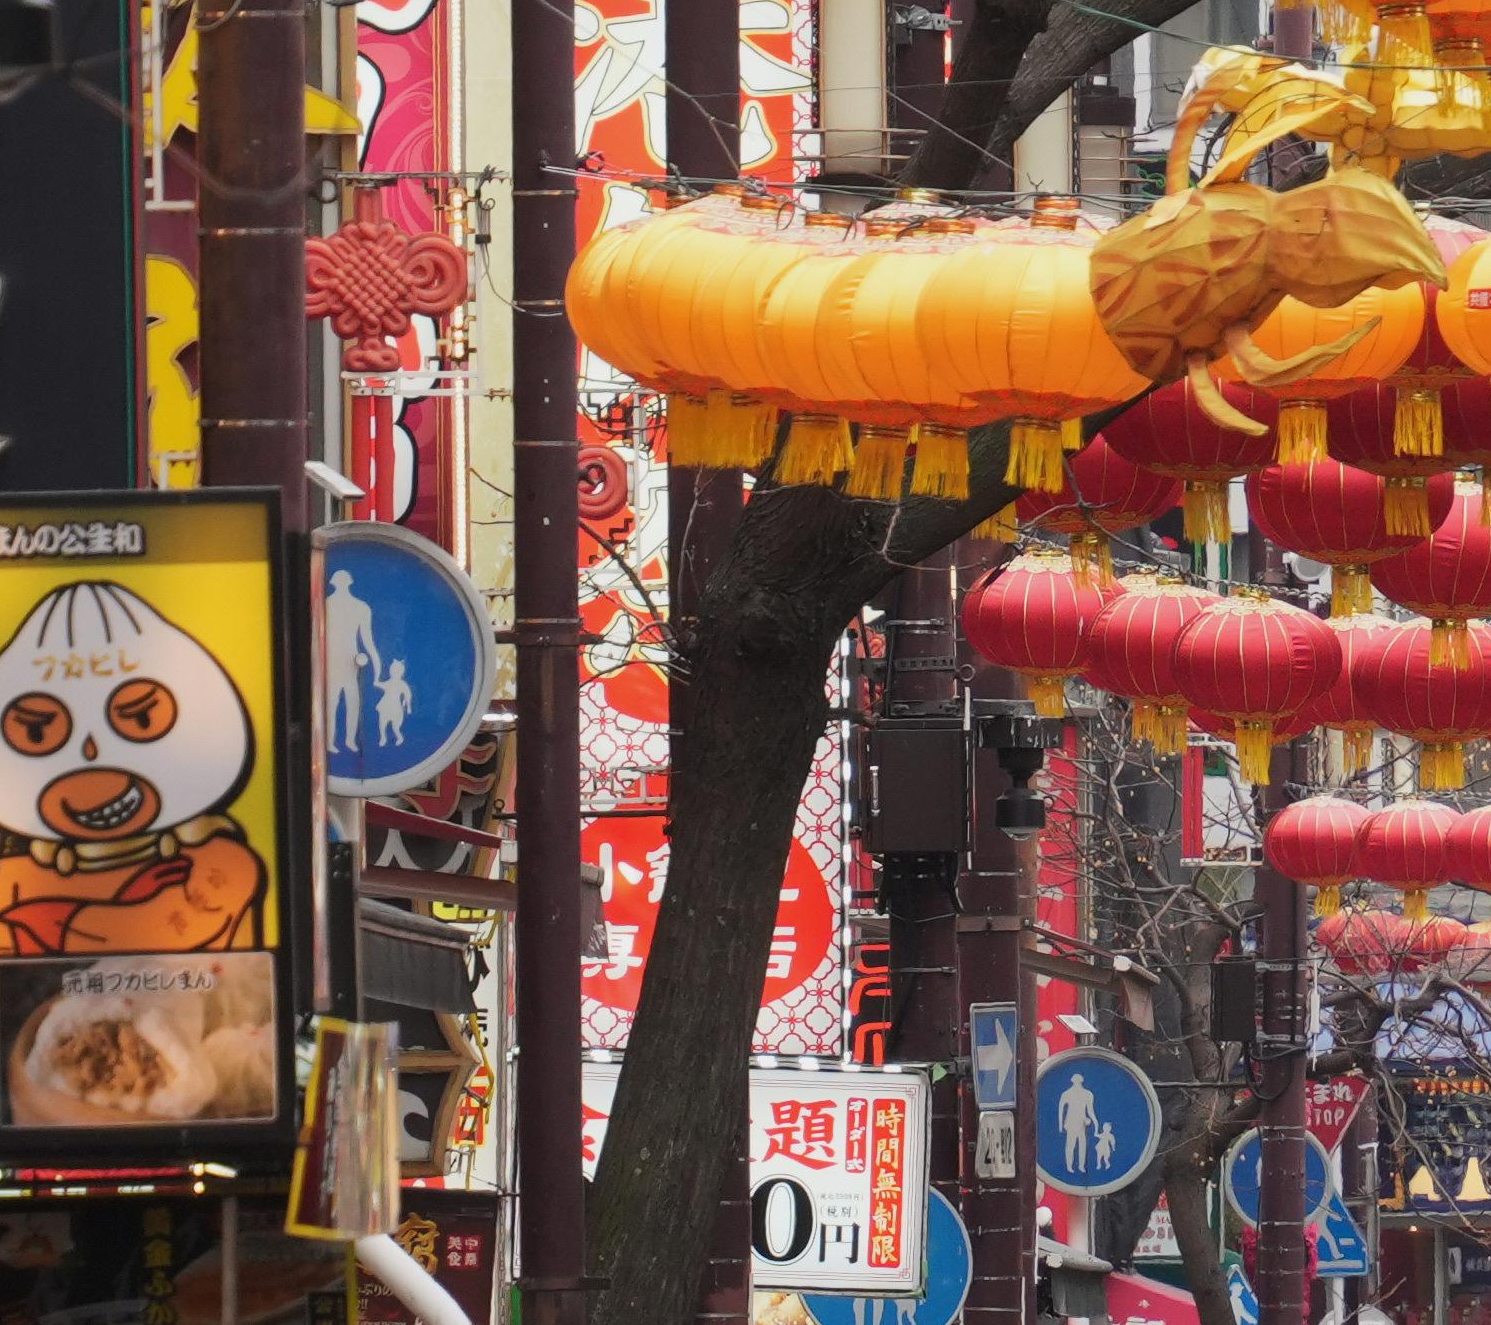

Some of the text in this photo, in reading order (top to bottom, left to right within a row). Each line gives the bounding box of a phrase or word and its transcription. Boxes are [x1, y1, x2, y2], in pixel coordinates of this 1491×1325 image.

[870, 1102, 905, 1265] 時間無制限
